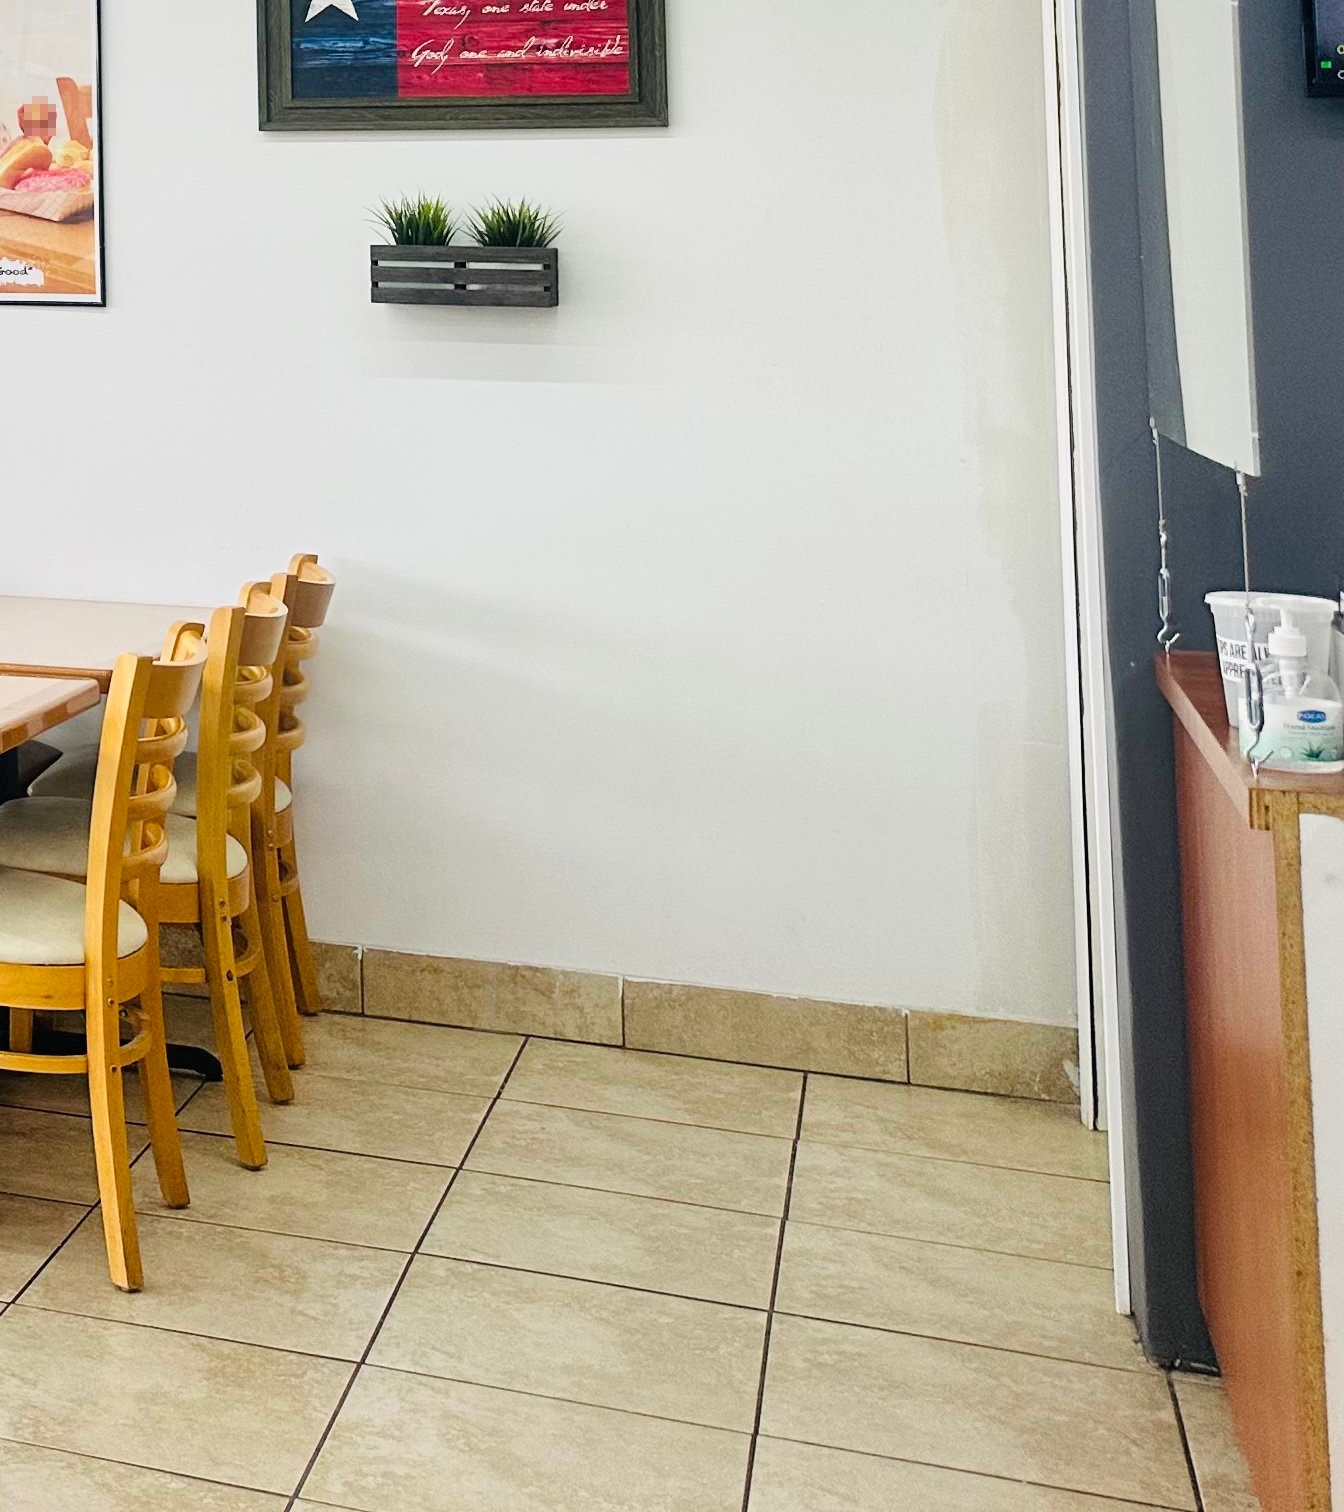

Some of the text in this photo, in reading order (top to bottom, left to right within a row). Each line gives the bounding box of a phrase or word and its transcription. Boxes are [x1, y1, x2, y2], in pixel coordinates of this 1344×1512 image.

[481, 2, 510, 15] one
[412, 37, 455, 76] God,
[496, 36, 536, 59] and
[536, 34, 624, 57] indivisible
